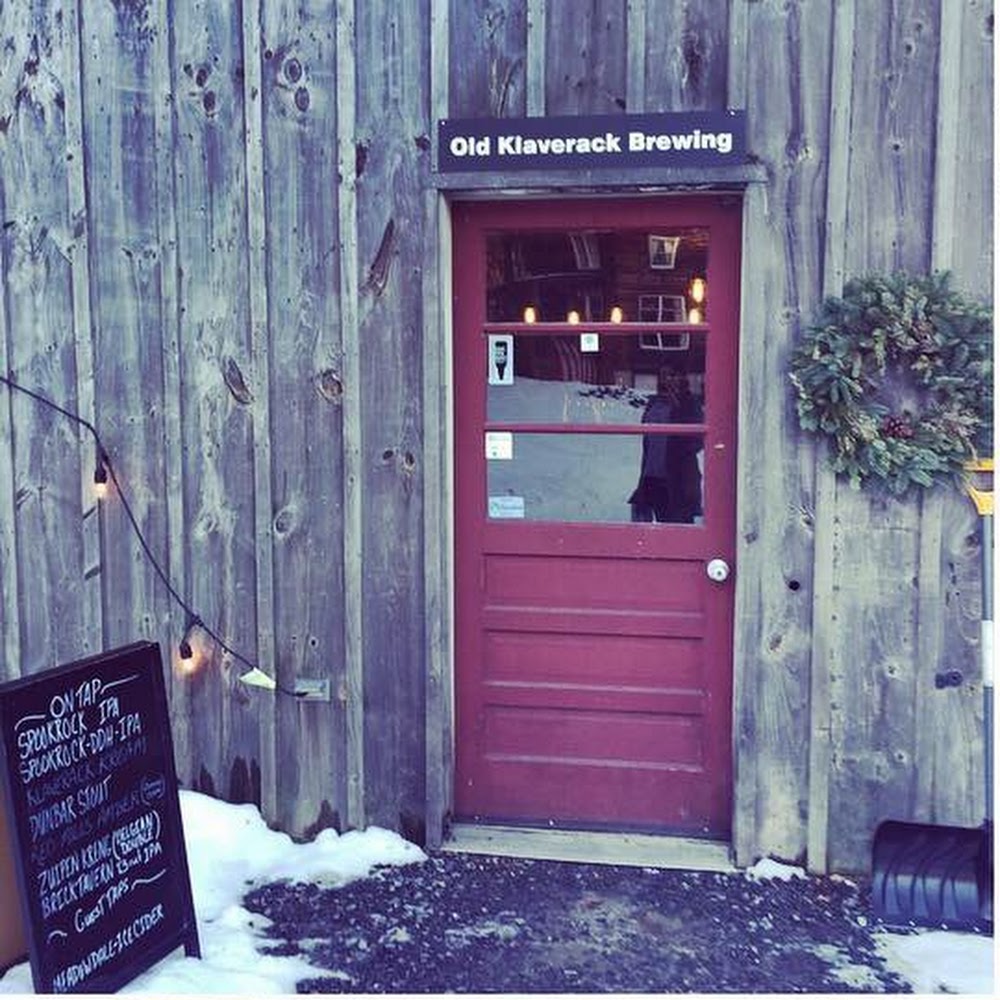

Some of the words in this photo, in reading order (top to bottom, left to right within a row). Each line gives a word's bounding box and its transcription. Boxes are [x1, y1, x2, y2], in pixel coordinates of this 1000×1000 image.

[450, 136, 490, 156] Old
[499, 133, 621, 156] Klaverack
[629, 129, 732, 153] Brewing
[50, 688, 74, 718] ON
[76, 678, 101, 708] TAP
